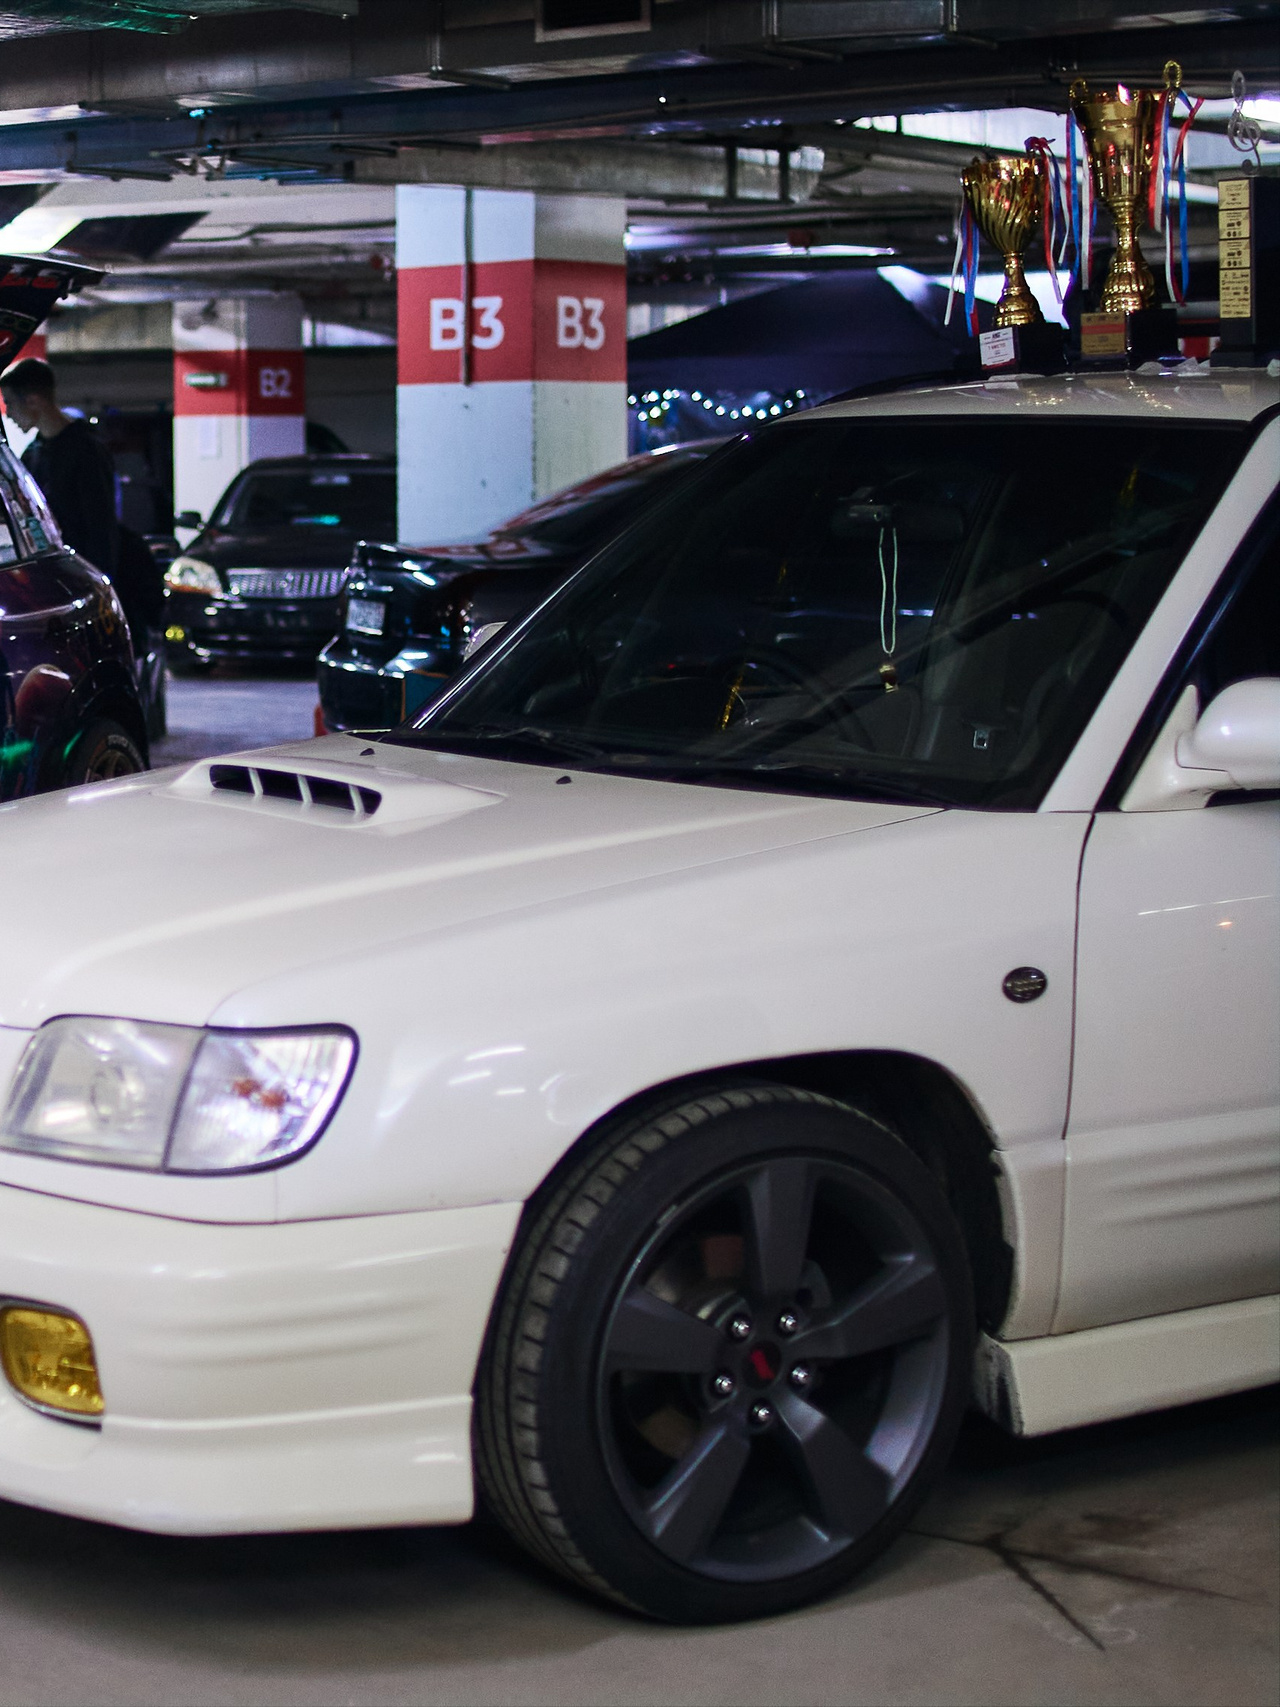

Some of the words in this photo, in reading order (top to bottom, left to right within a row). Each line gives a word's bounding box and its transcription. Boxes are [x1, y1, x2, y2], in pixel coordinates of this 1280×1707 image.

[429, 296, 505, 350] B3
[557, 296, 606, 350] B3
[260, 368, 292, 397] B2
